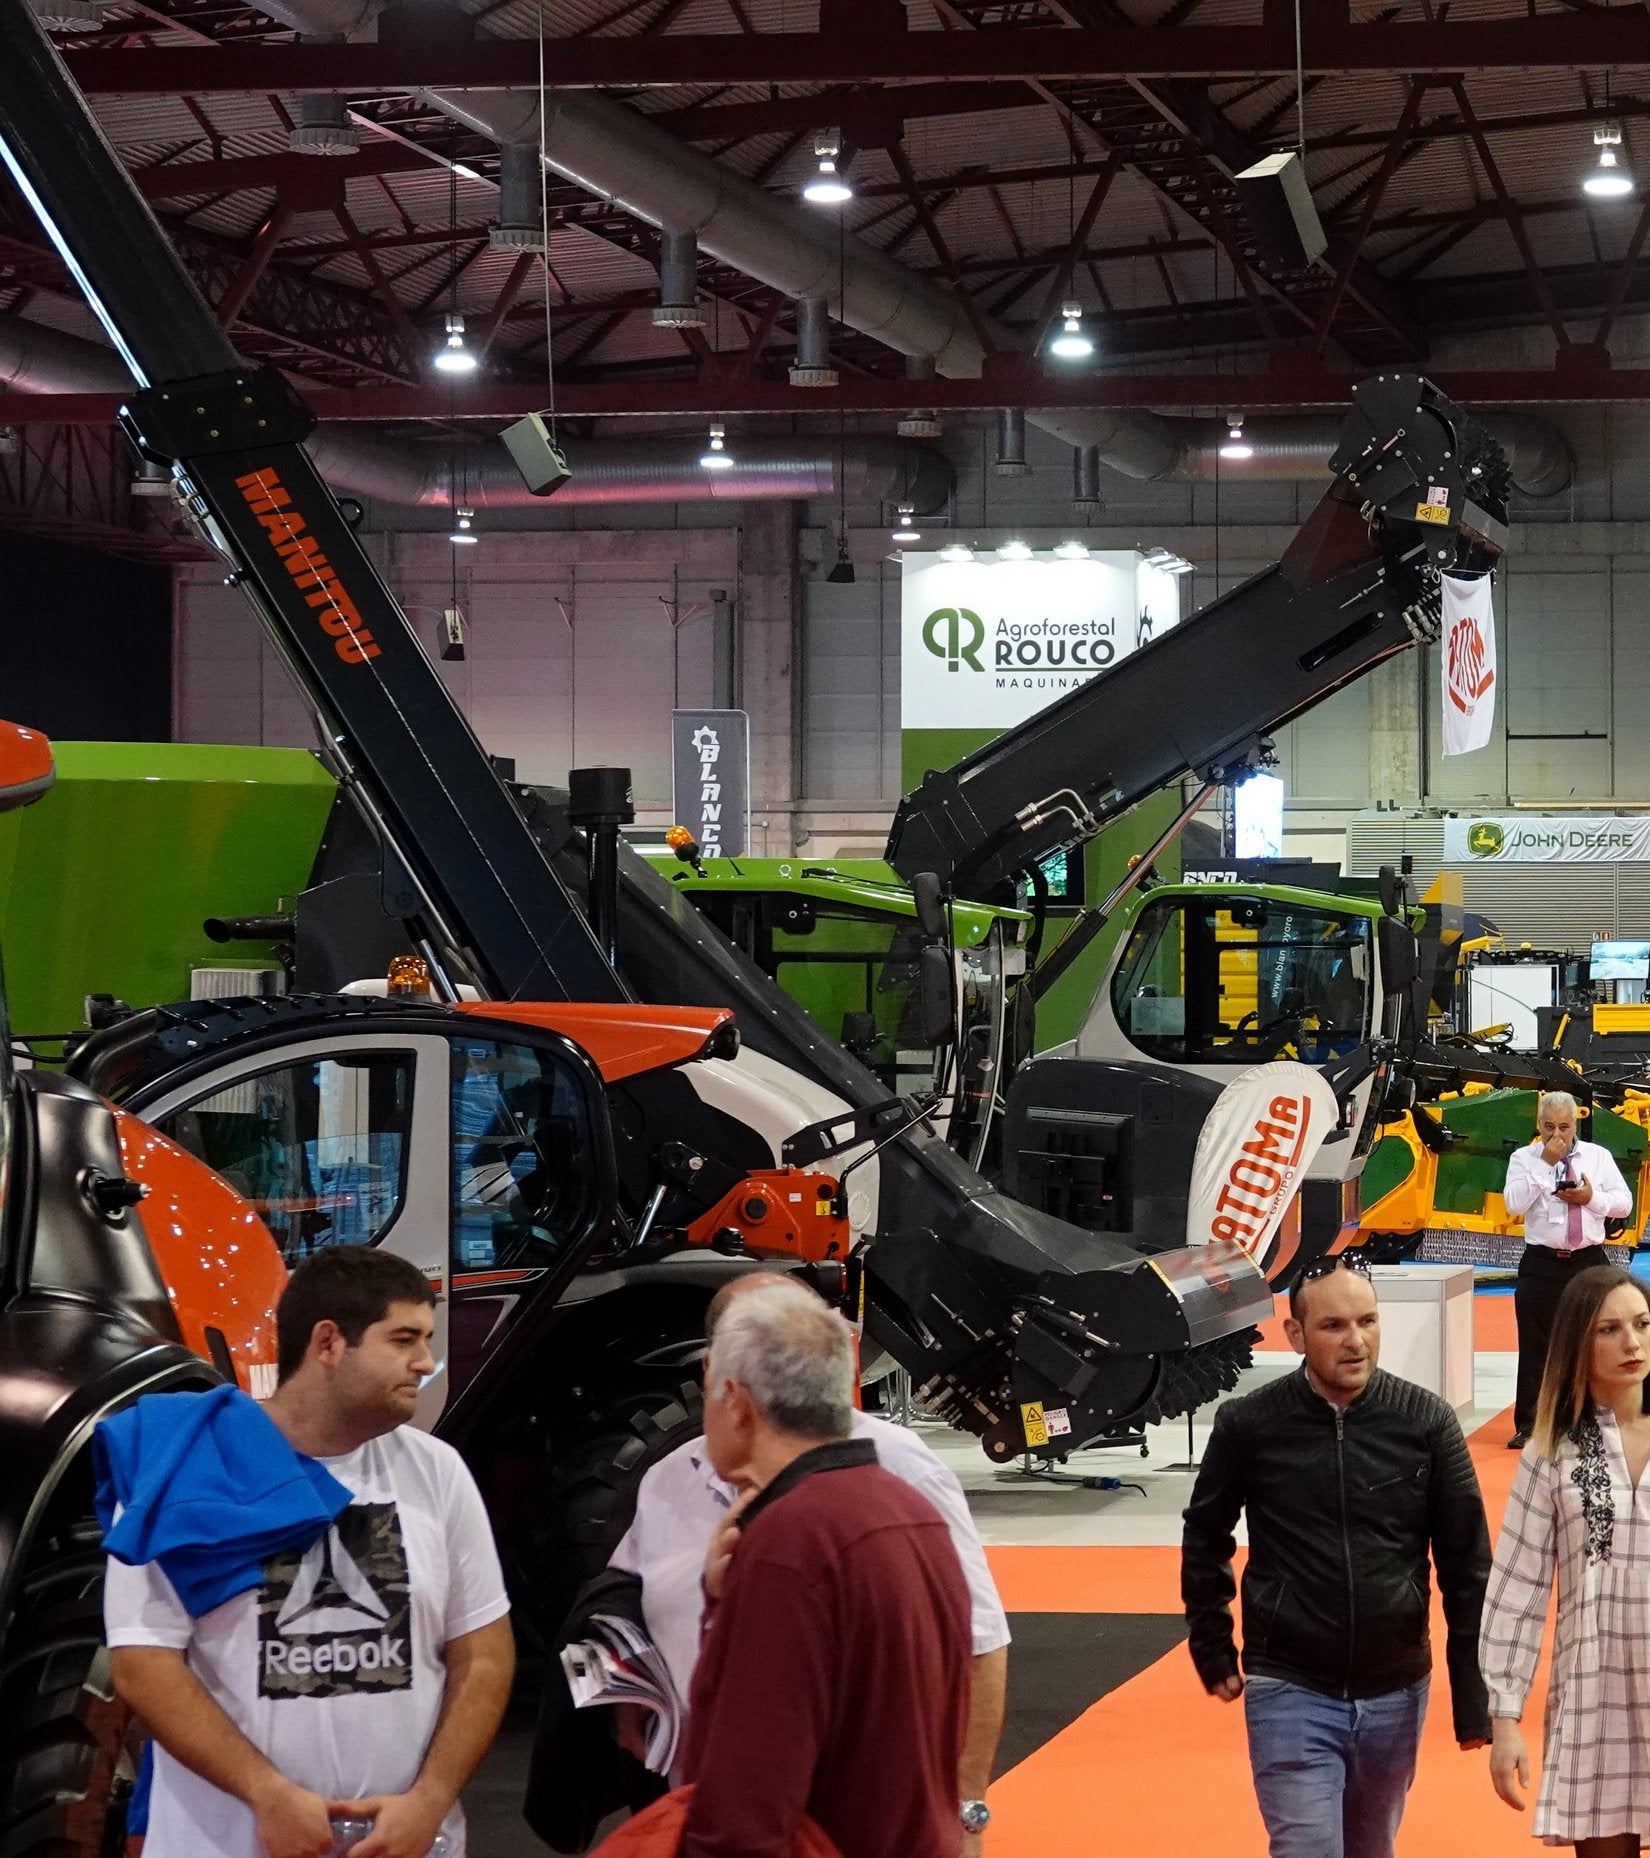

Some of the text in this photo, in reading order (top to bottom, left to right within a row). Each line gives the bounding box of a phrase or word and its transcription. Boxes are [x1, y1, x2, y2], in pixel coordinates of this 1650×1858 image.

[234, 467, 383, 664] MANITOU
[996, 617, 1115, 642] Agroforestal
[995, 640, 1115, 666] ROUCO
[700, 744, 722, 858] BLANCO
[1511, 831, 1633, 848] JOHN DEERE
[1271, 916, 1293, 998] www.blanoyoro
[1209, 1095, 1299, 1247] ATOMA
[1270, 1171, 1295, 1215] GRUPO
[265, 1634, 405, 1675] Reebok
